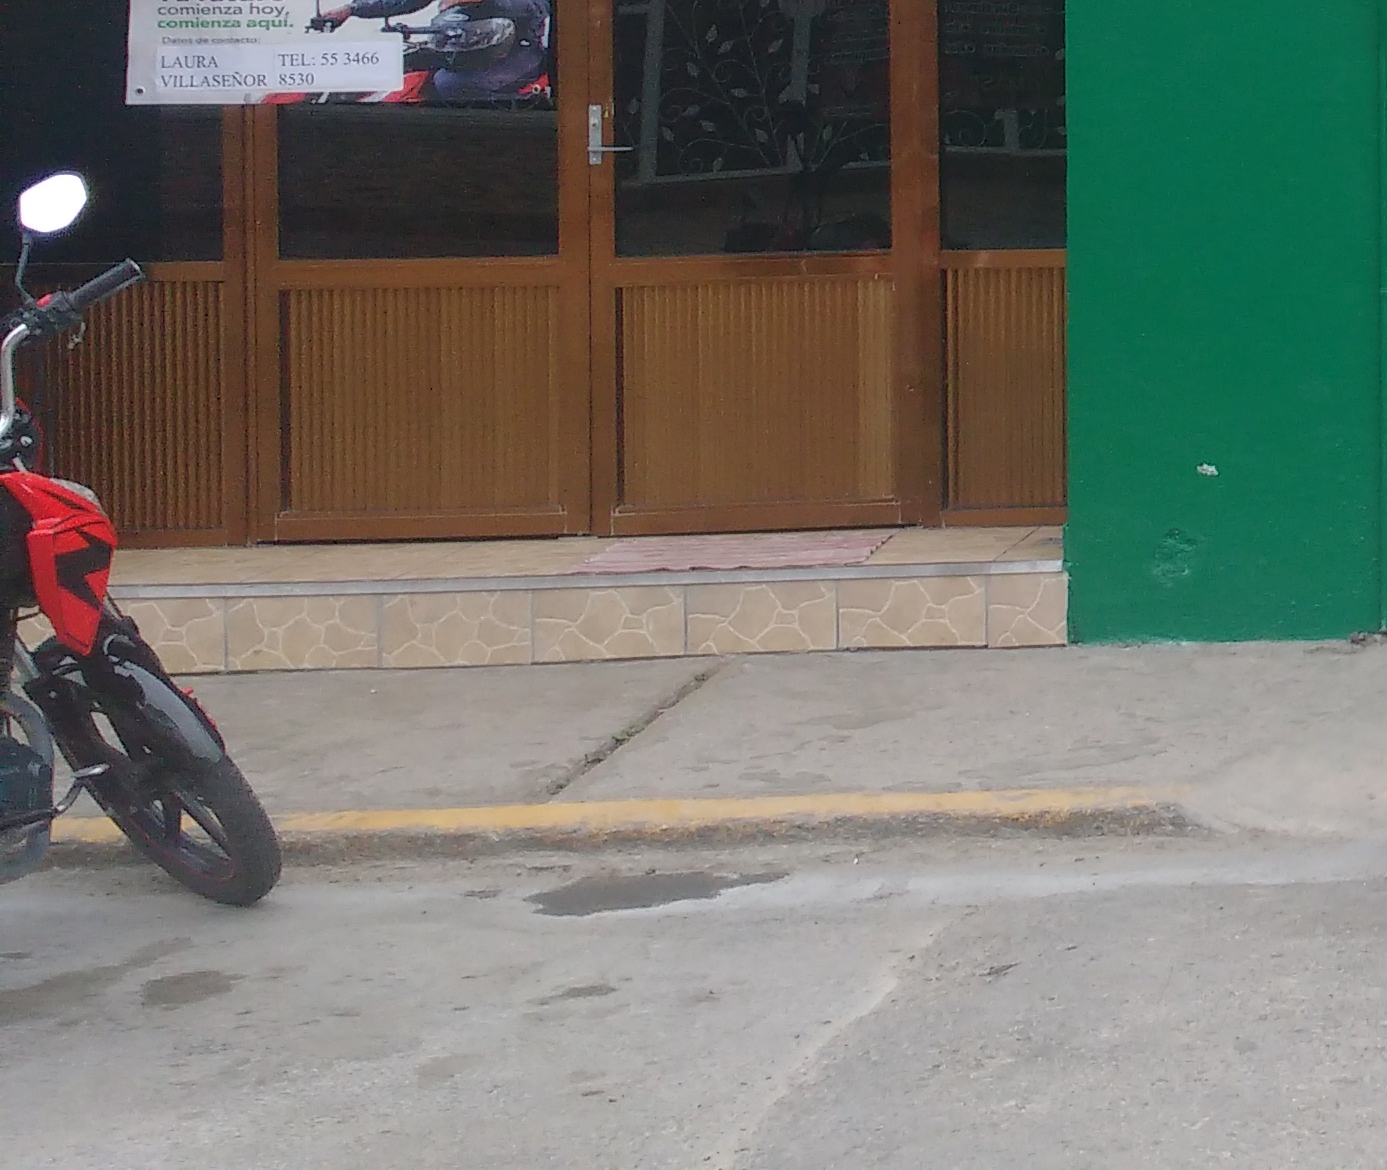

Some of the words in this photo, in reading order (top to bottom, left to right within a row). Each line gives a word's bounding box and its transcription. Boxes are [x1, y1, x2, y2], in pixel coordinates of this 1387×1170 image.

[157, 4, 243, 17] comienza
[249, 3, 290, 18] hoy,
[157, 17, 241, 29] comienza
[246, 16, 294, 31] aquí.
[160, 55, 219, 69] LAURA
[278, 53, 316, 67] TEL:
[320, 52, 339, 67] 55
[343, 51, 380, 66] 3466
[160, 72, 268, 89] VILLASEÑOR
[278, 72, 315, 86] 8530
